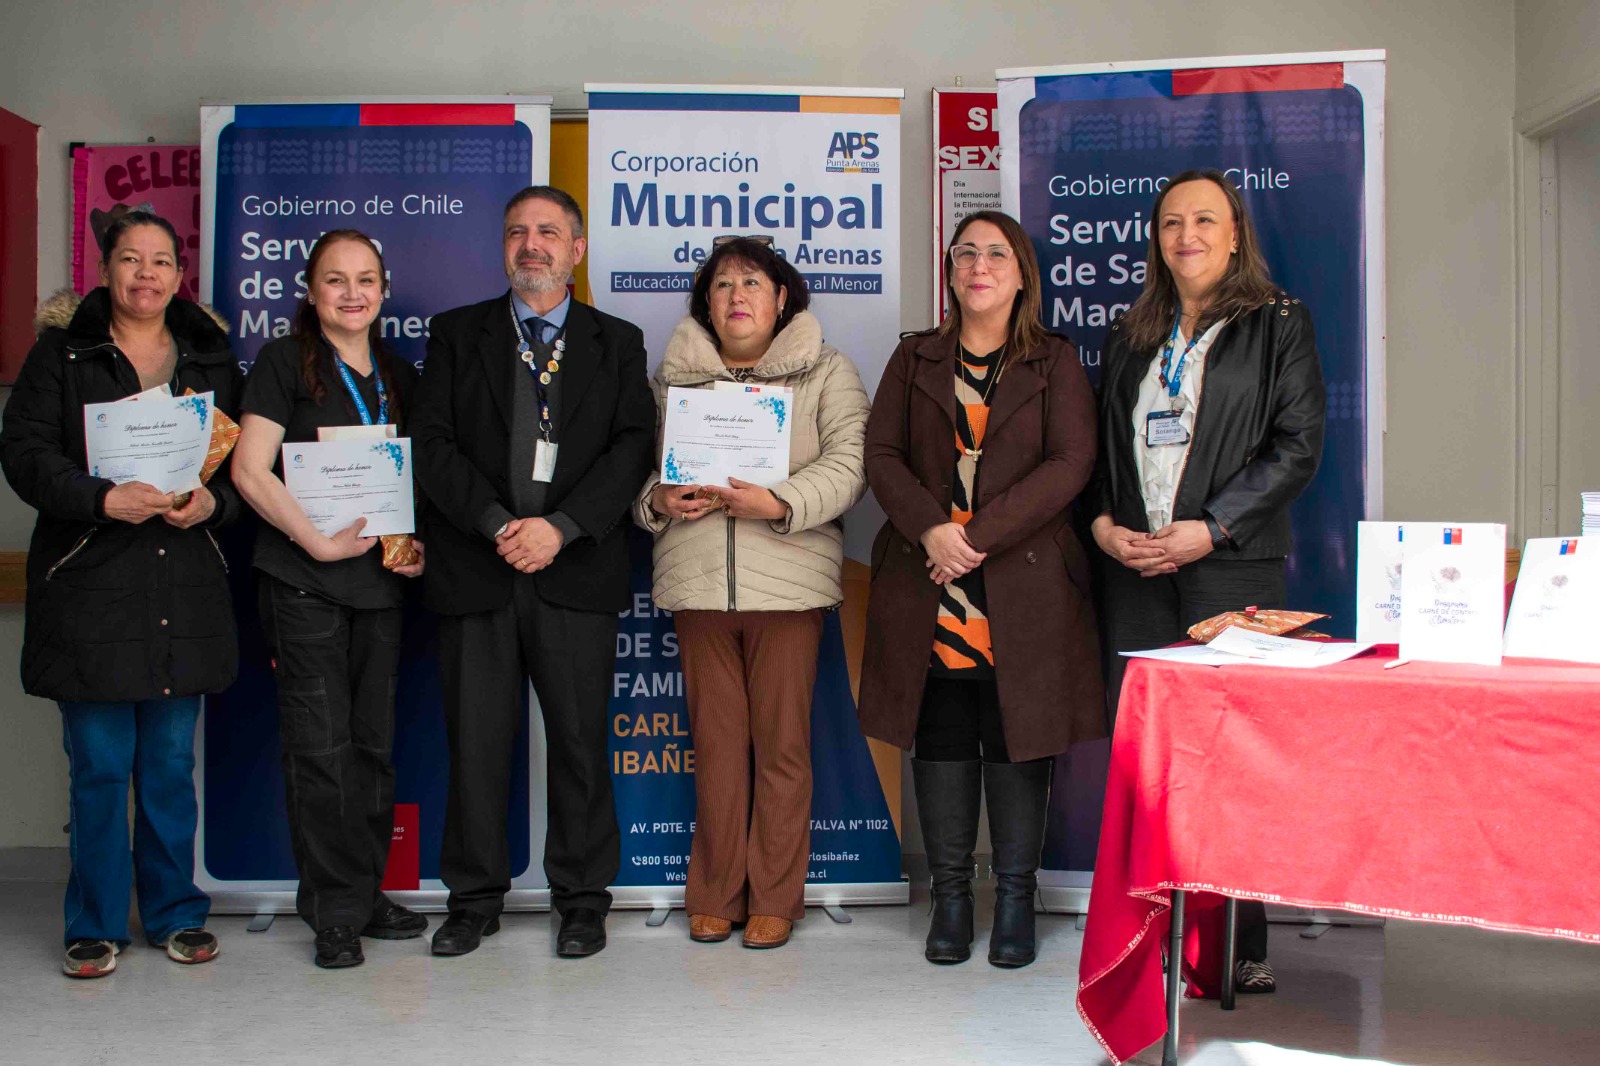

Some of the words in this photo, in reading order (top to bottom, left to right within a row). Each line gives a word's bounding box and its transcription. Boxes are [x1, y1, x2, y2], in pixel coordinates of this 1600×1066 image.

[827, 132, 880, 160] APS
[611, 150, 758, 177] Corporación
[826, 159, 850, 167] Punta
[852, 159, 880, 168] Arenas
[1049, 173, 1170, 197] Gobierno
[1223, 168, 1290, 190] Chile
[242, 195, 356, 216] Gobierno
[364, 195, 393, 215] de
[402, 194, 464, 215] Chile
[611, 182, 882, 241] Municipal
[1049, 211, 1151, 246] Servi
[674, 241, 706, 263] de
[794, 243, 882, 266] Arenas
[614, 275, 690, 289] Educación
[814, 276, 826, 290] al
[831, 276, 878, 291] Menor
[1050, 255, 1096, 287] de
[239, 271, 283, 300] de
[616, 633, 651, 658] DE
[613, 672, 683, 698] FAMI
[613, 713, 689, 738] CARL
[613, 743, 696, 775] IBAÑE
[630, 822, 650, 834] AV.
[652, 822, 686, 834] PDTE.
[866, 819, 889, 830] 1102
[641, 855, 661, 866] 800
[663, 855, 682, 865] 500
